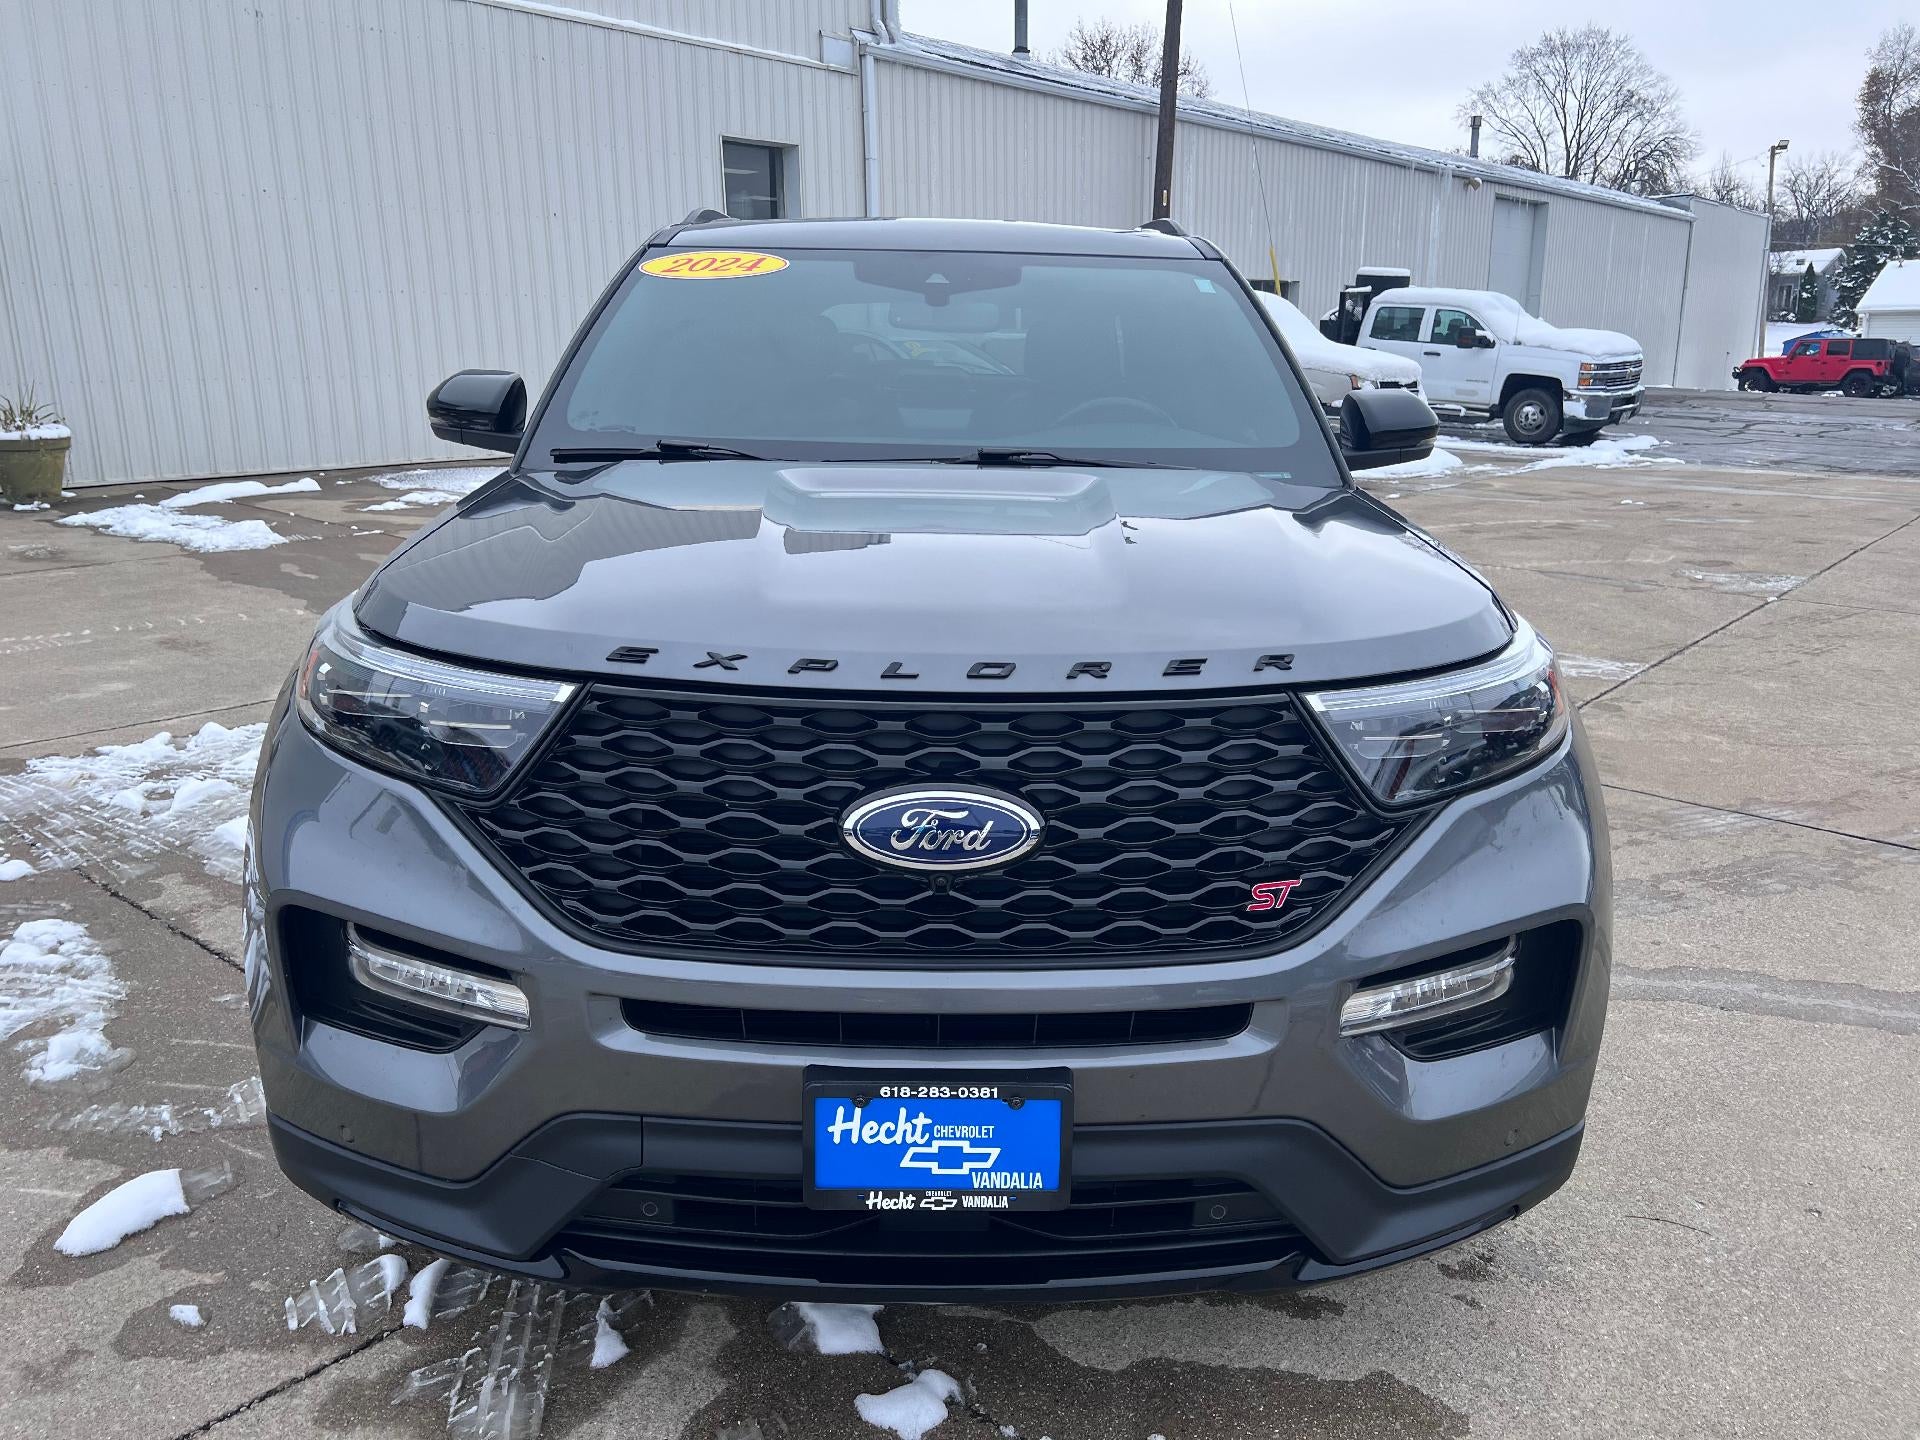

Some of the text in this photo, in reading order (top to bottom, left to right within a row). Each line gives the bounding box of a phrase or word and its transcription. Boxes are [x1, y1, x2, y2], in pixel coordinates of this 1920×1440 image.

[660, 257, 767, 273] 2024
[605, 645, 1296, 679] EXPLORER
[890, 808, 994, 851] Ford
[1246, 879, 1302, 911] ST
[879, 1086, 998, 1099] 618-283-0381
[827, 1105, 995, 1145] Hecht CHEVROLET
[971, 1172, 1043, 1189] VANDALIA
[865, 1191, 1009, 1210] Hecht VANDALIA
